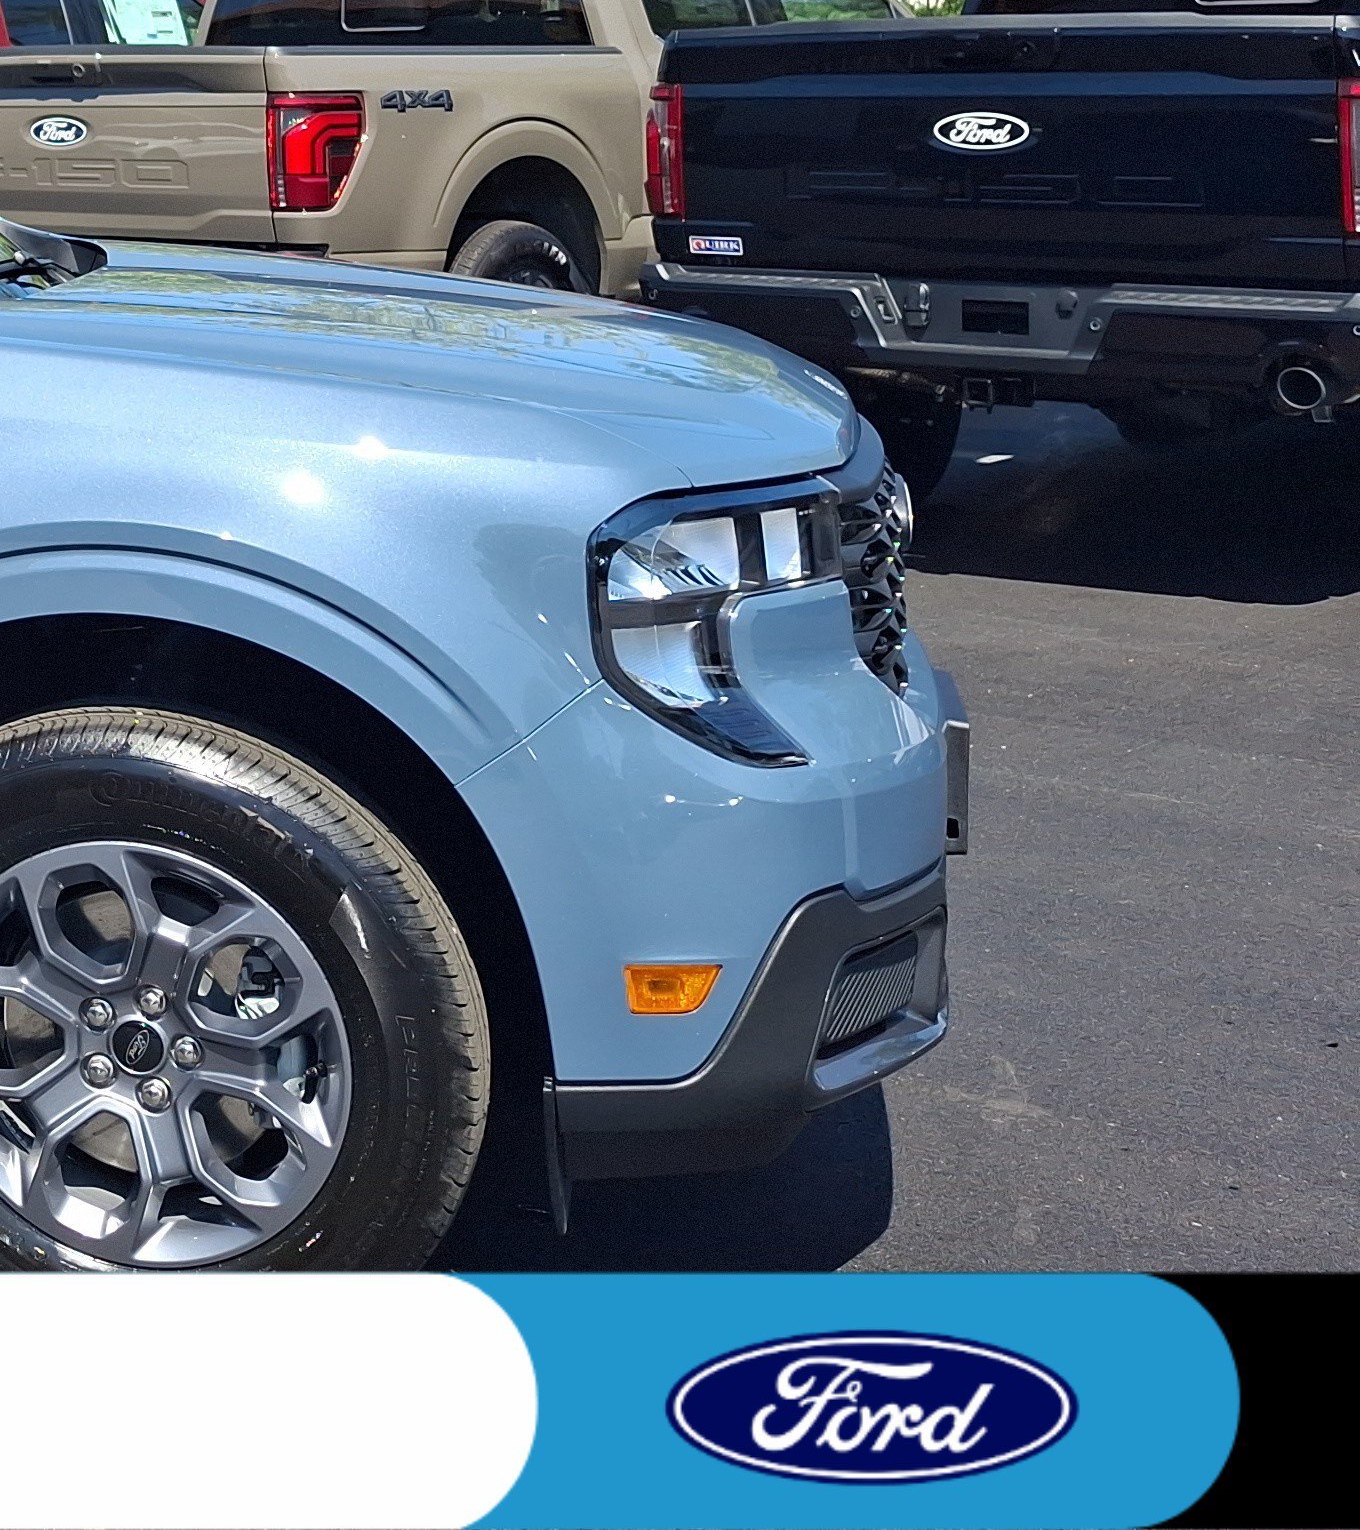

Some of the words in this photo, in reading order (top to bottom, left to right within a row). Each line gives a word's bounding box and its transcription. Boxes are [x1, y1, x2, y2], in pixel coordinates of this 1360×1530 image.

[39, 120, 77, 142] Ford
[949, 117, 1012, 144] Ford
[692, 239, 740, 250] QUIRK
